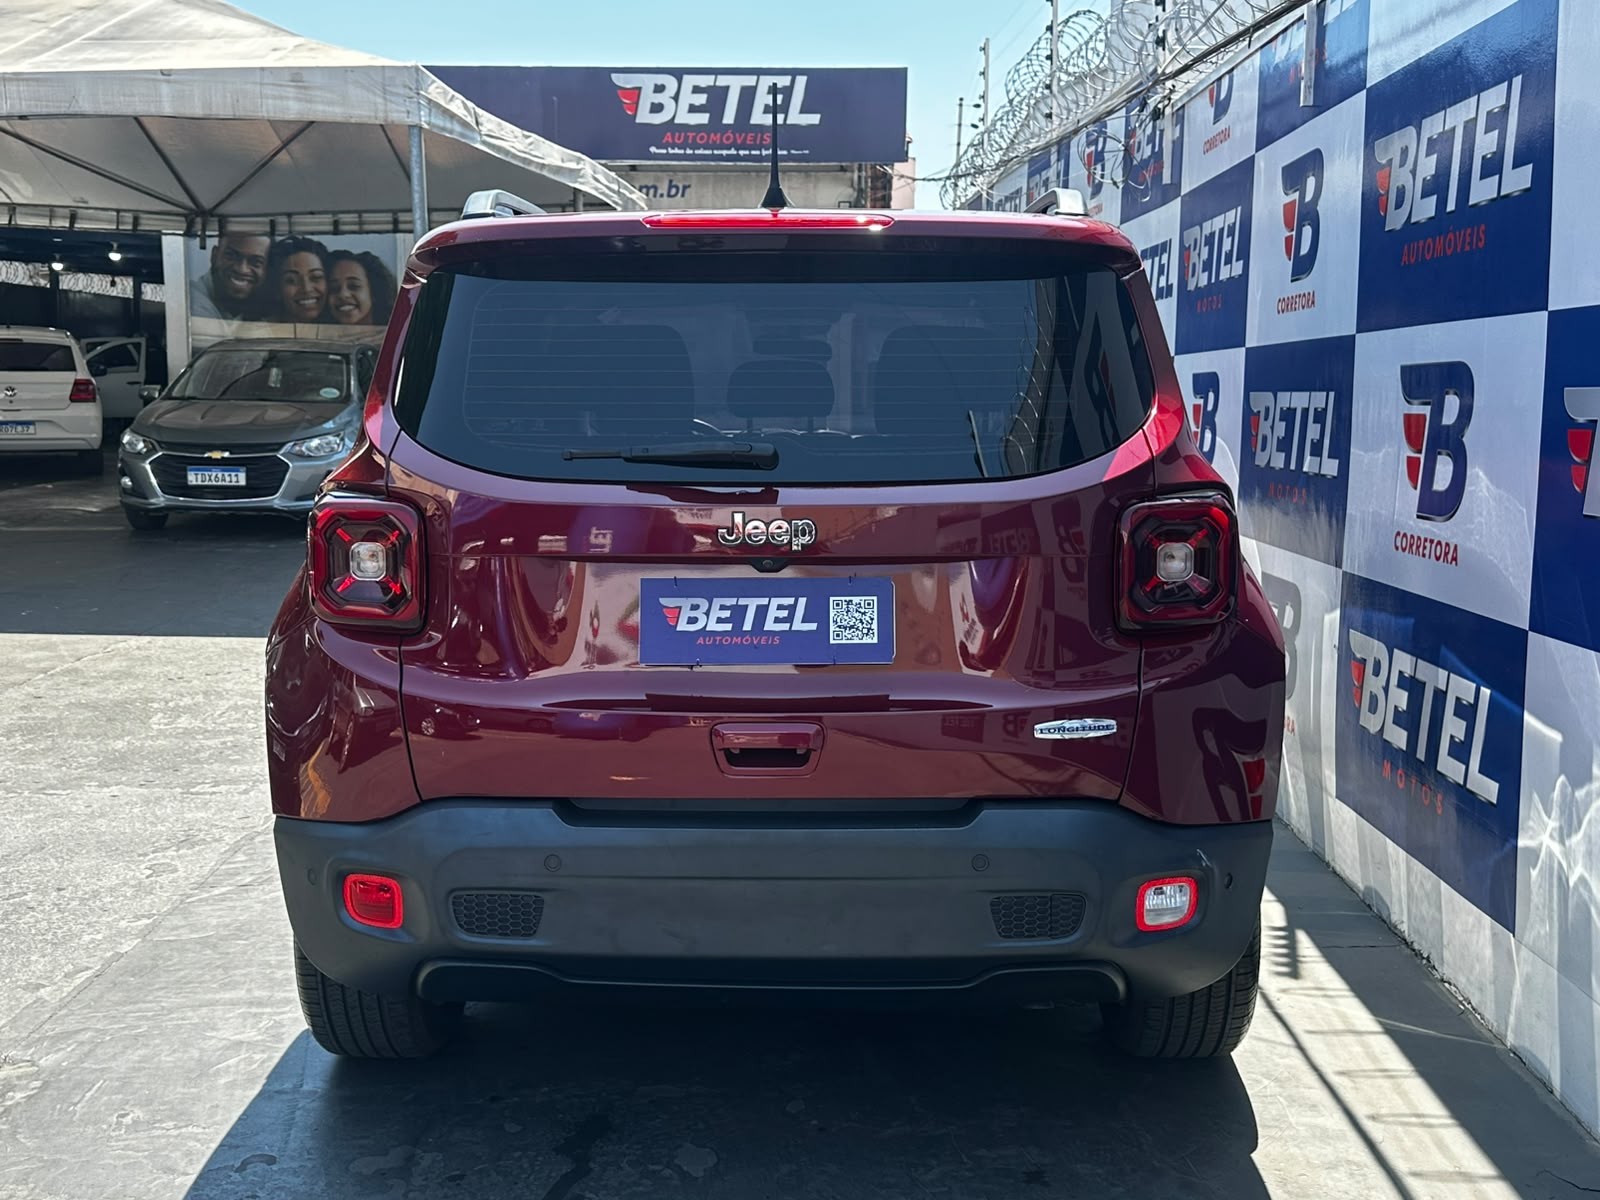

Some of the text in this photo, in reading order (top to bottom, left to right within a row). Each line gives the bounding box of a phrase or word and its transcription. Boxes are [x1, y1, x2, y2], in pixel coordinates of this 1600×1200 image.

[610, 73, 821, 125] BETEL
[662, 130, 772, 145] AUTOMÓVEIS
[1374, 74, 1533, 232] BETEL
[1183, 205, 1243, 291] BETEL
[1401, 224, 1486, 266] AUTOMÓVEIS
[1276, 290, 1316, 315] CORRETORA
[1249, 391, 1339, 477] BETEL
[193, 472, 240, 484] TDX6A11
[1269, 482, 1308, 505] MOTOS
[717, 512, 817, 551] Jeep
[1394, 530, 1459, 567] CORRETORA
[658, 597, 818, 632] BETEL
[697, 635, 780, 645] AUTOMÓVEIS
[1039, 723, 1115, 735] LONGITUDE
[1349, 629, 1500, 805] BETEL
[1382, 759, 1443, 815] MOTOS
